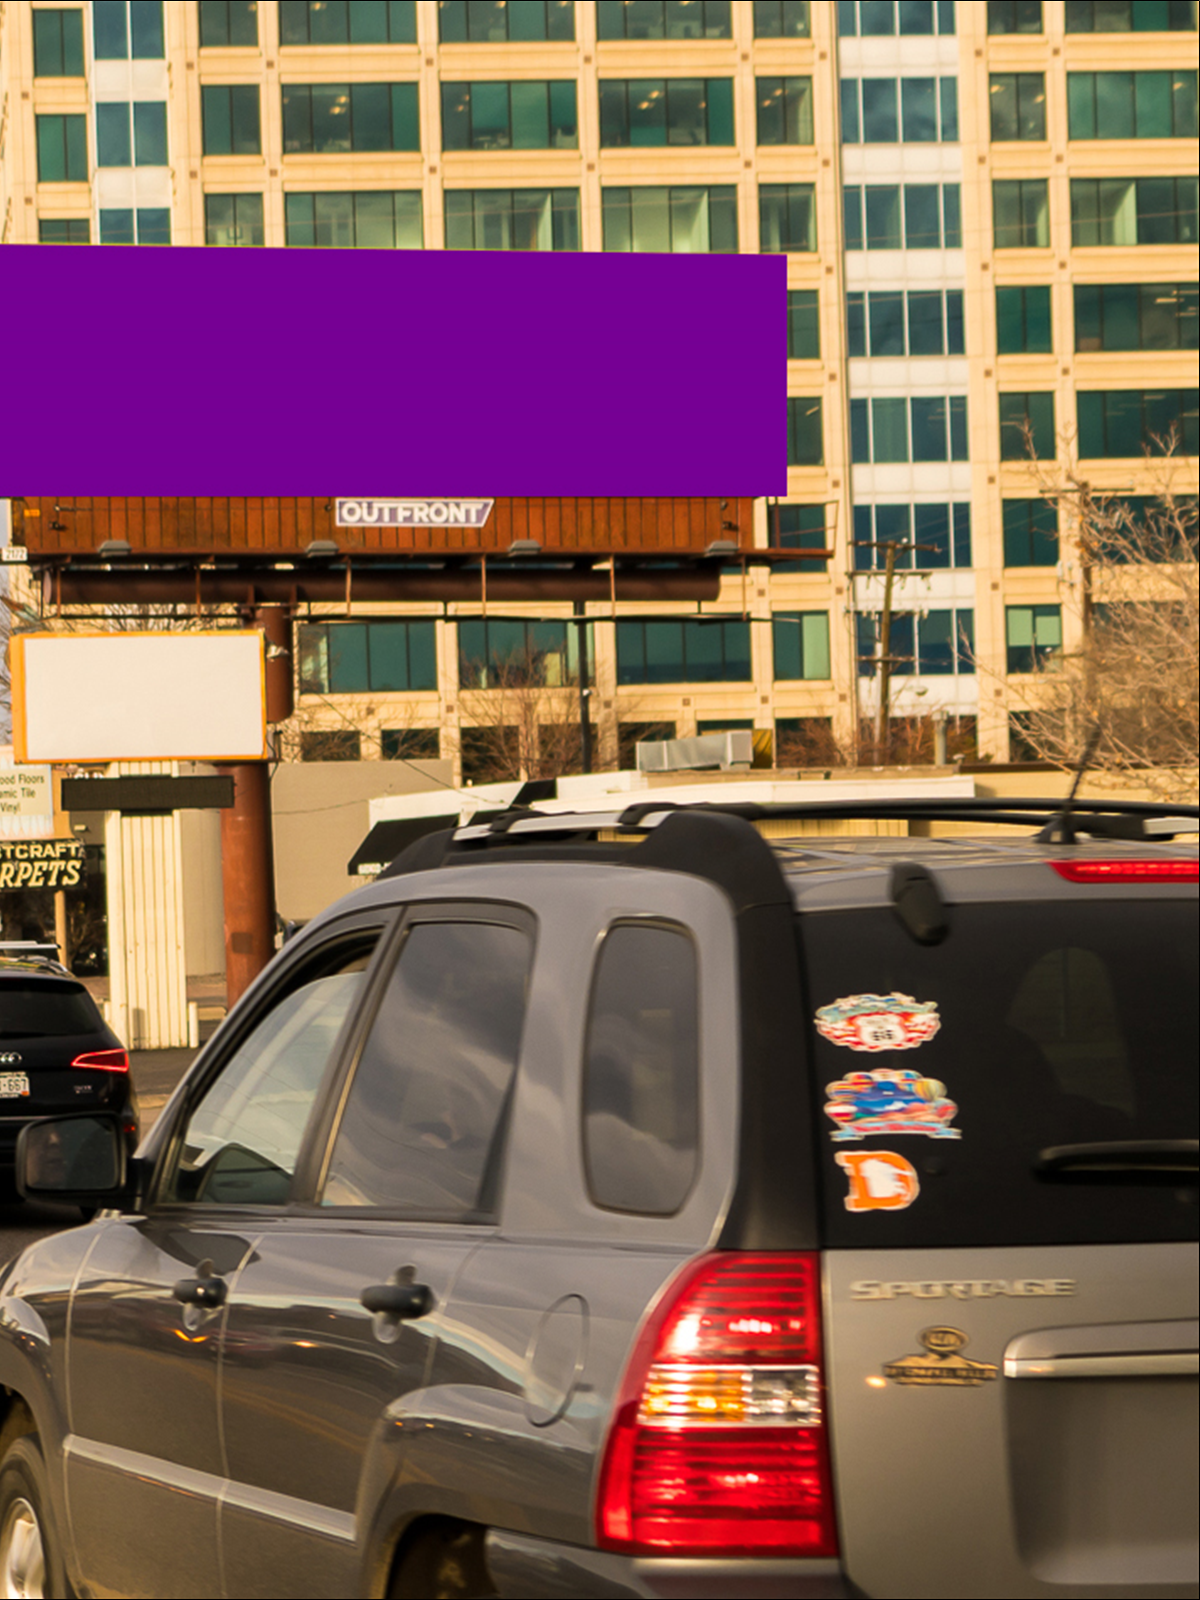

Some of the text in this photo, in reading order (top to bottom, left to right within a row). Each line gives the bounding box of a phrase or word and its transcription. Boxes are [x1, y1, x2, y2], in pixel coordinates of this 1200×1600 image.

[341, 502, 484, 523] OUTFRONT
[18, 773, 45, 784] Floors
[21, 787, 36, 798] Tile
[0, 802, 21, 814] Vinyl
[850, 1279, 1077, 1300] SPORTAGE
